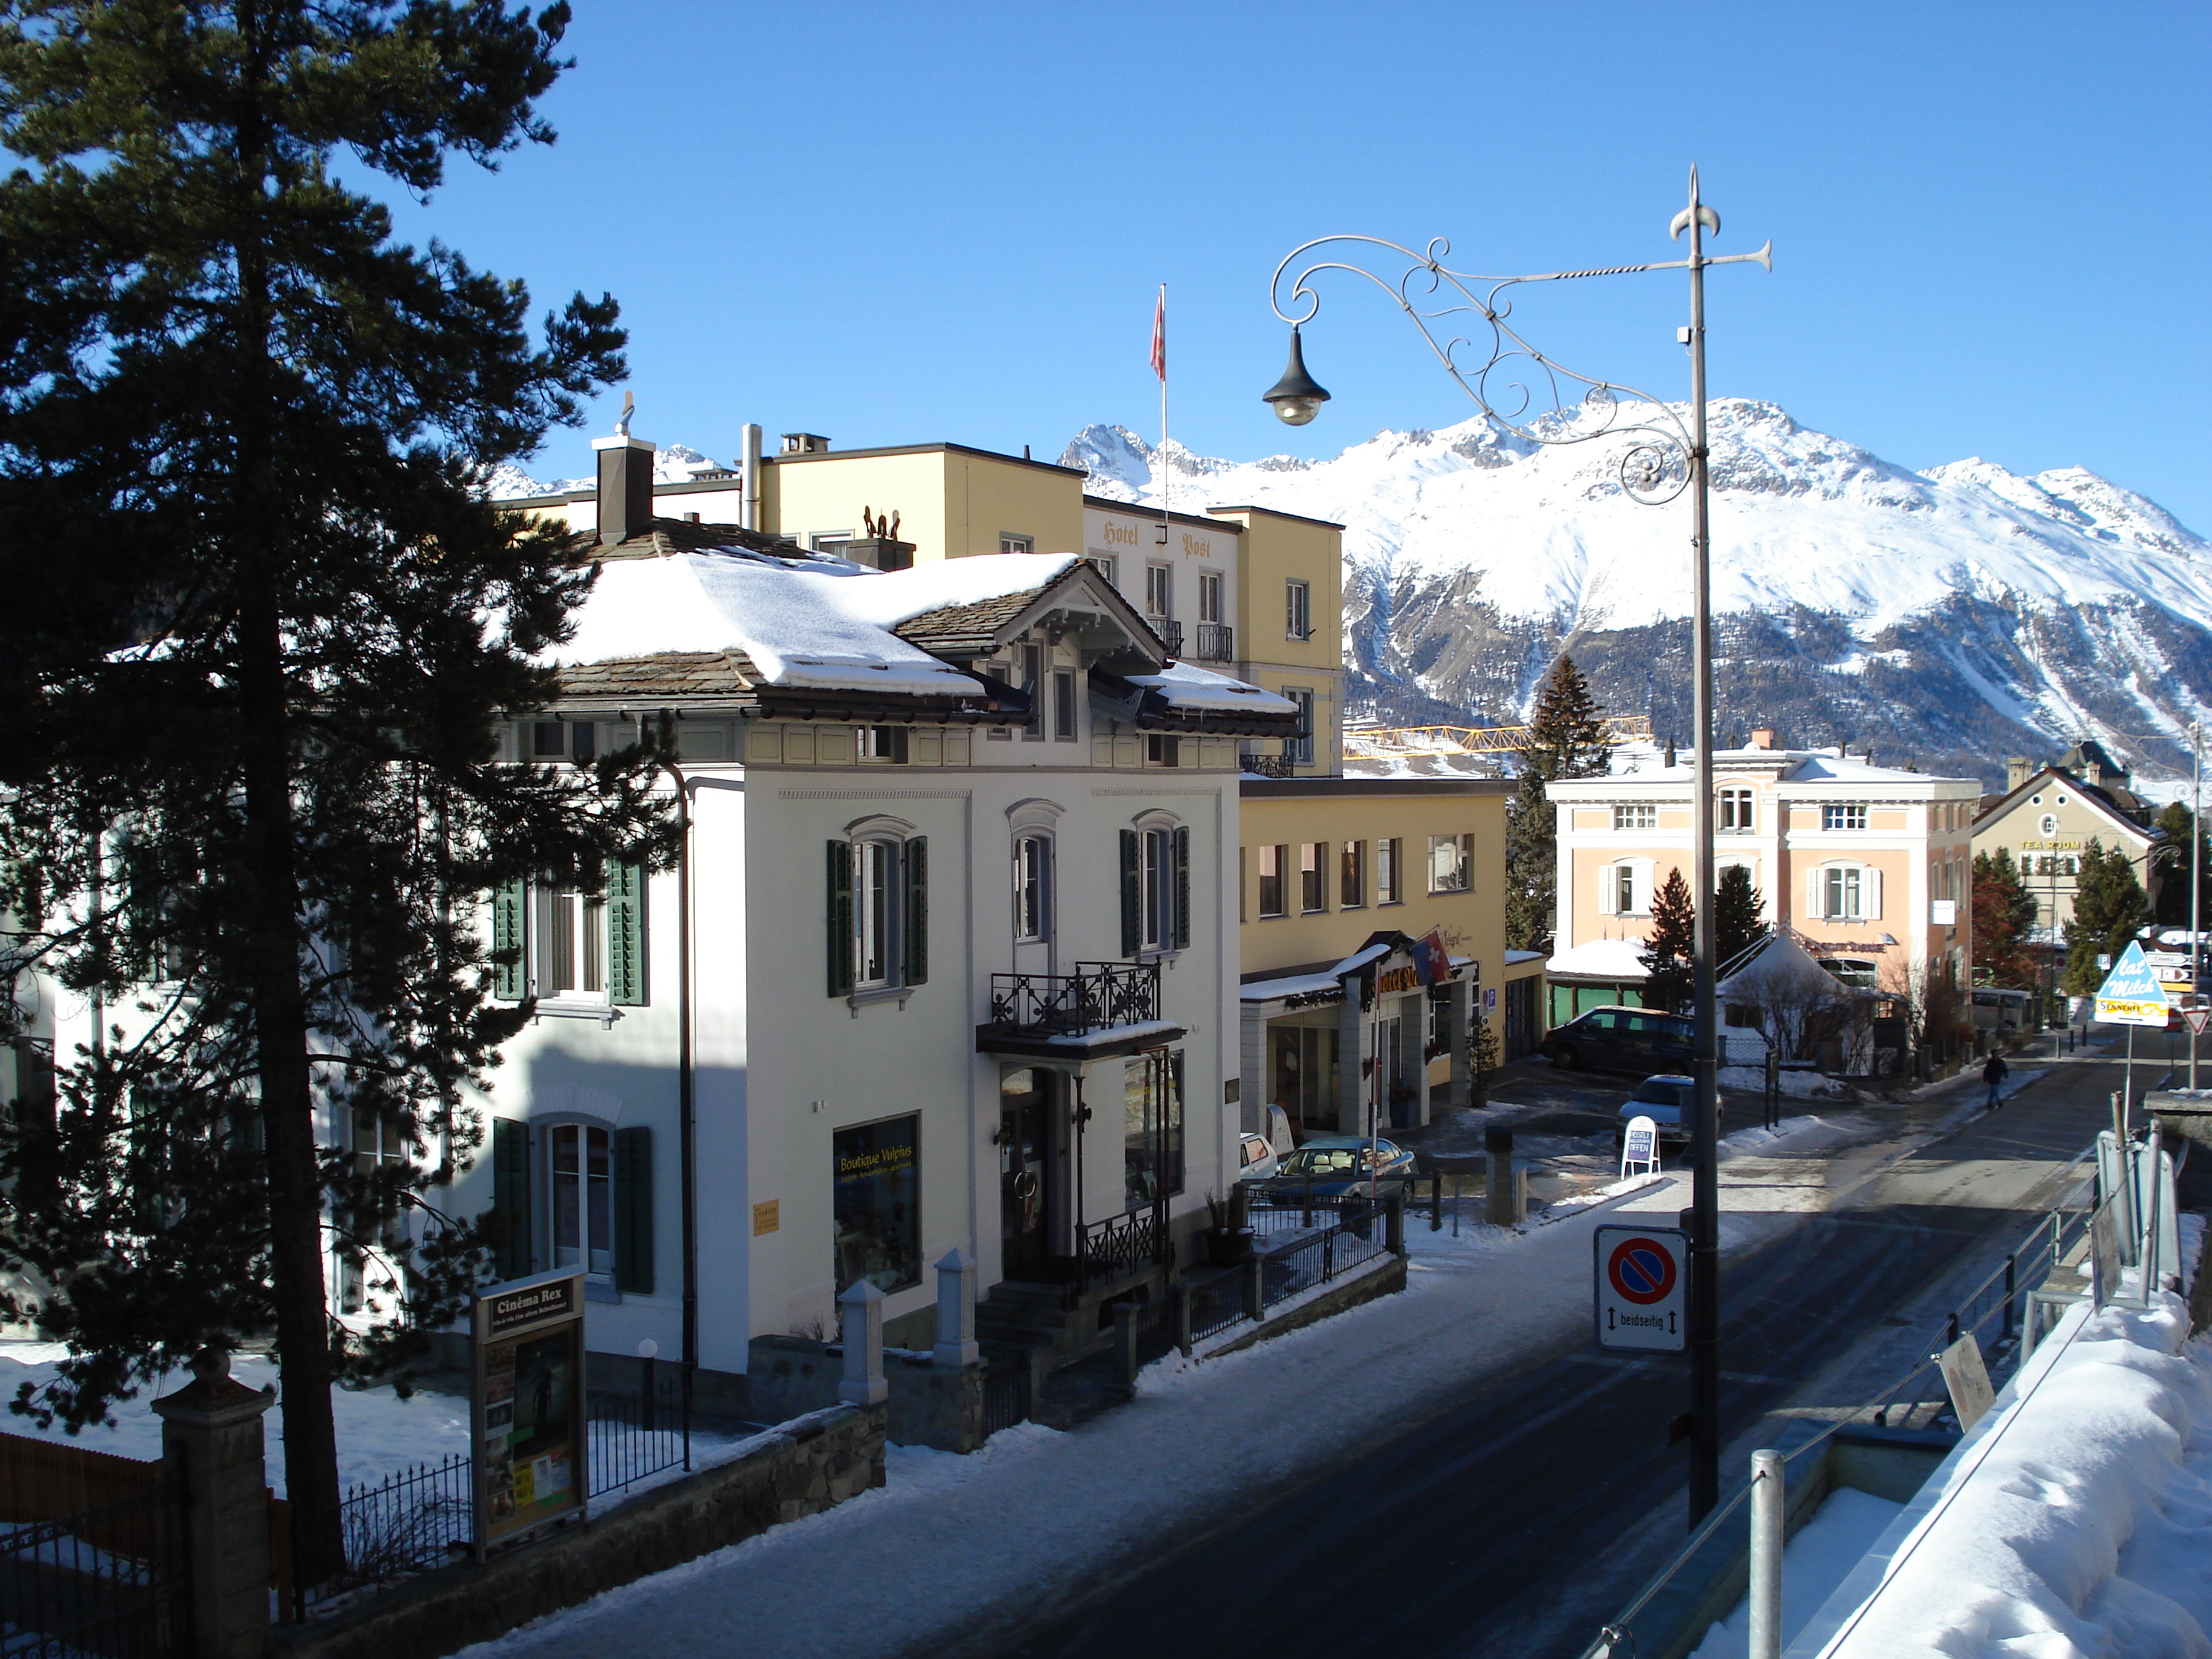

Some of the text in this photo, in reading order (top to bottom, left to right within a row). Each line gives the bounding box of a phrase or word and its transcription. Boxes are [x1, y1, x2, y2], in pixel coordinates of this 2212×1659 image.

[1103, 520, 1211, 560] Hotel Post
[2020, 840, 2081, 850] TEA ROOM
[2108, 976, 2154, 997] Milch
[840, 1144, 912, 1172] Boutique Vulpius
[1629, 1143, 1649, 1152] OFFEN
[498, 1288, 562, 1314] Cinéma Rex
[1621, 1313, 1663, 1331] beidseitig
